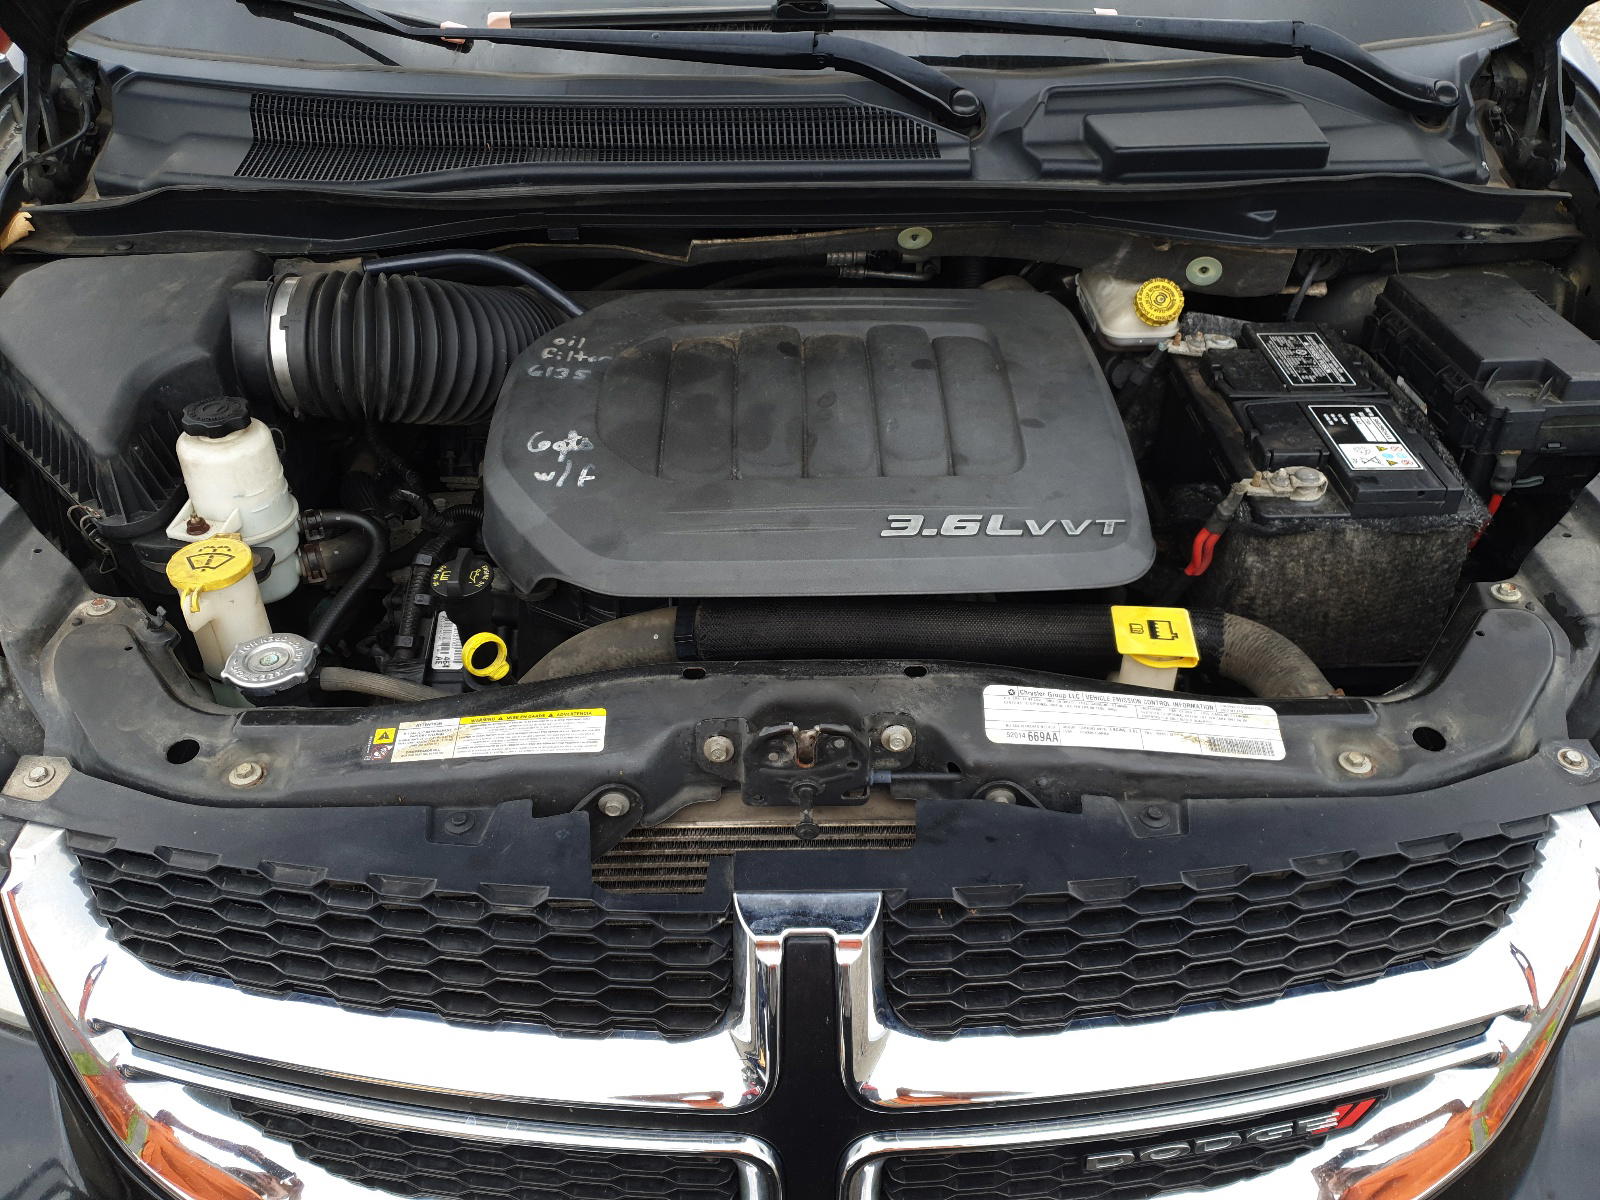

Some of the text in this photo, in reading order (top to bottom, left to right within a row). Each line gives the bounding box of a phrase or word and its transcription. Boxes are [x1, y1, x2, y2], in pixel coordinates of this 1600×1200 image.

[880, 514, 1128, 538] 3.6L VVT
[1019, 689, 1045, 698] Chrysler
[1047, 691, 1067, 699] Group
[1085, 694, 1110, 702] VEHICLE
[1112, 696, 1142, 704] EMISSION
[1144, 699, 1170, 707] CONTROL
[1172, 701, 1214, 711] INFORMATION
[1028, 731, 1059, 743] 669AA
[1085, 1111, 1341, 1172] DODGE
